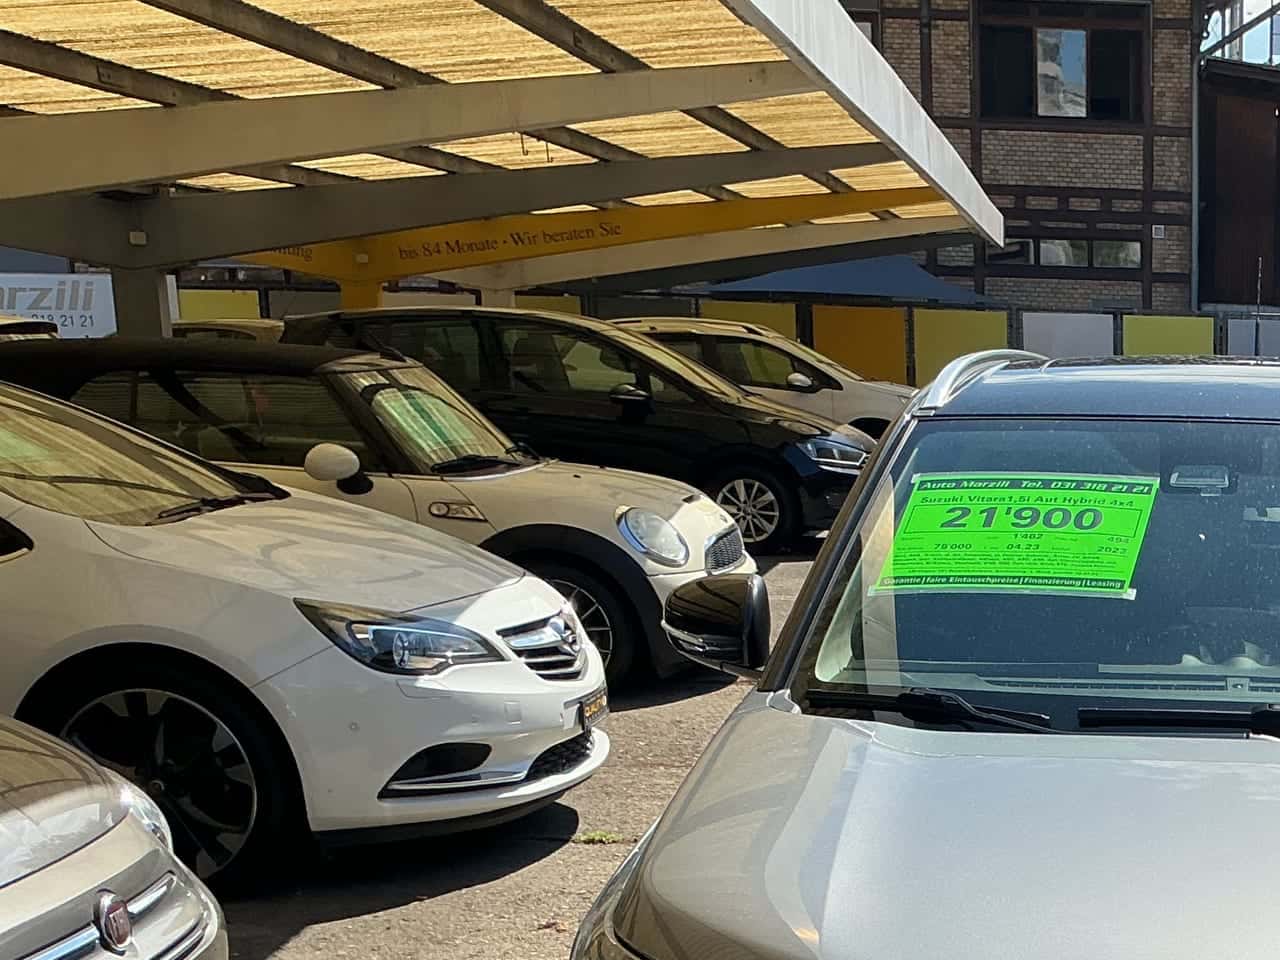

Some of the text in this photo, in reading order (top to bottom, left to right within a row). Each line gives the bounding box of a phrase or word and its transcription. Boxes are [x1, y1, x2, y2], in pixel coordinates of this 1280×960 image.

[421, 242, 442, 257] 84
[445, 238, 498, 255] Monate
[509, 231, 537, 247] Wir
[542, 227, 594, 244] beraten
[599, 222, 623, 237] Sie
[61, 315, 74, 327] 21
[80, 315, 94, 327] 21
[921, 480, 956, 489] Auto
[1021, 480, 1044, 489] Tel.
[1051, 481, 1077, 489] 031
[1111, 484, 1128, 492] 21
[1132, 485, 1149, 493] 21
[1062, 496, 1106, 505] Hybrid
[940, 506, 1103, 530] 21'900
